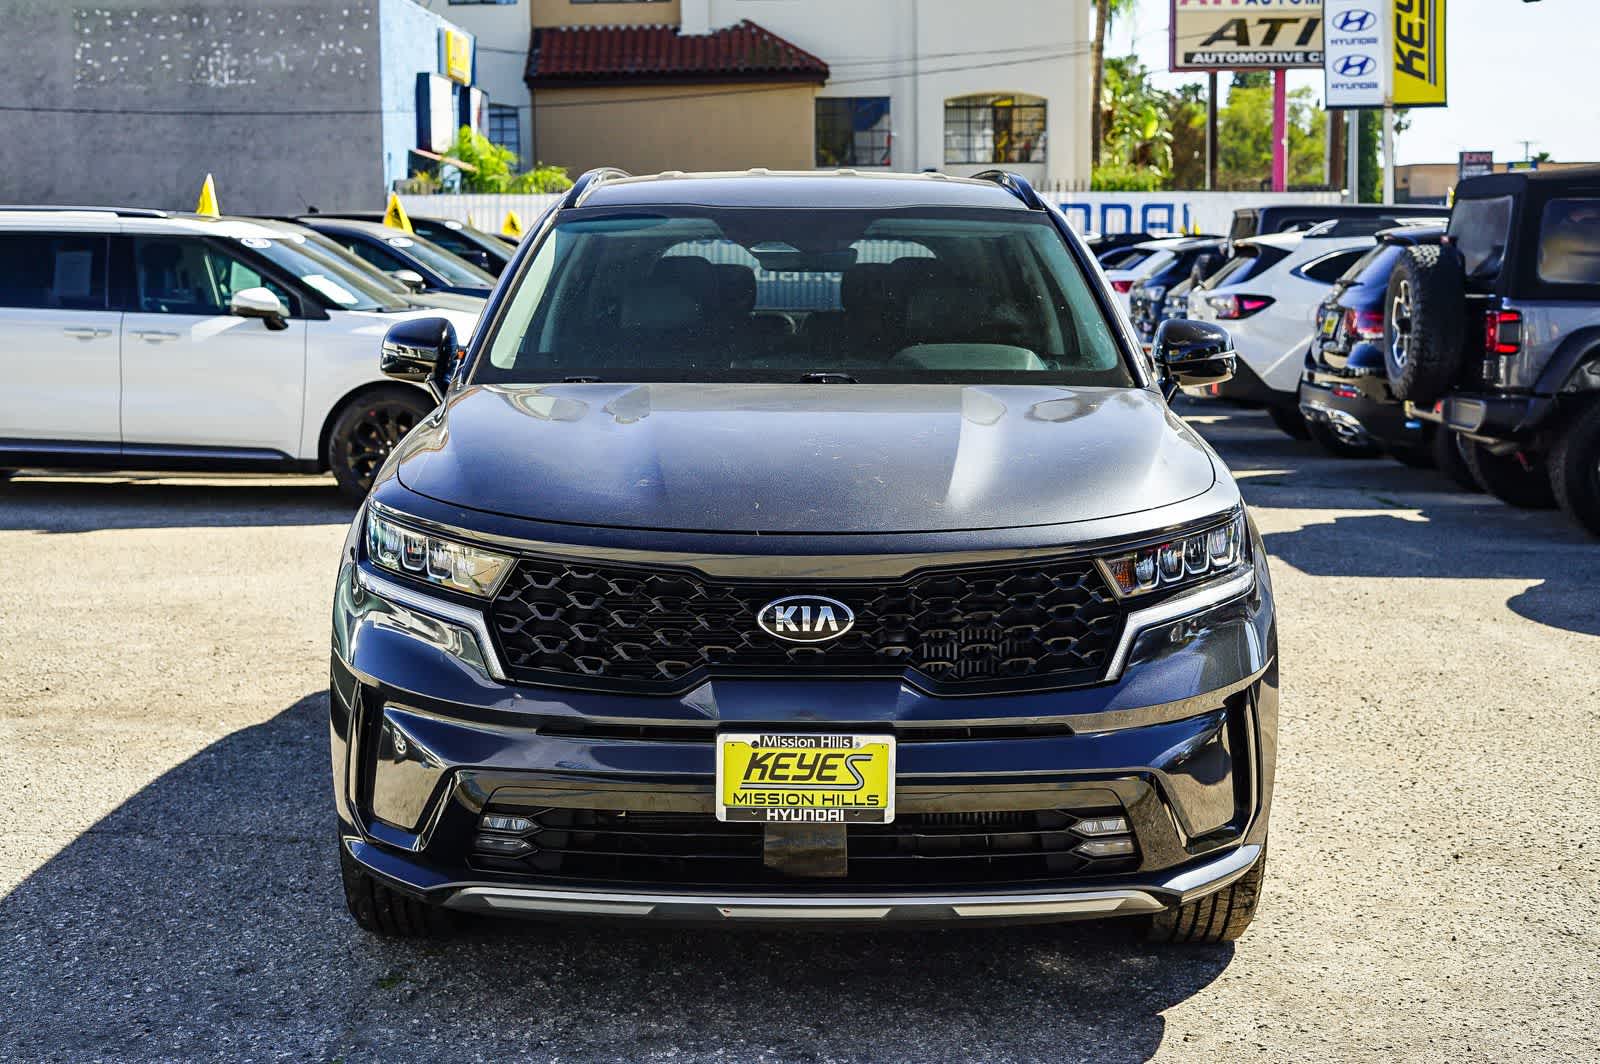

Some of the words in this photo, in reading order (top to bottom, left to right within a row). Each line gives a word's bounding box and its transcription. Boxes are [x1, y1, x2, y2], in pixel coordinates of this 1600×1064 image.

[1199, 18, 1321, 47] ATI
[1331, 37, 1378, 46] HYUNDAI
[1191, 52, 1304, 63] AUTOMOTIVE
[1331, 81, 1378, 89] HYUNDAI
[774, 605, 839, 632] KIA
[763, 736, 815, 748] Mission
[820, 736, 851, 748] Hills
[741, 752, 873, 790] KEYES
[733, 792, 814, 806] MISSION
[822, 793, 879, 806] HILLS
[766, 809, 845, 822] HYUNDAI
